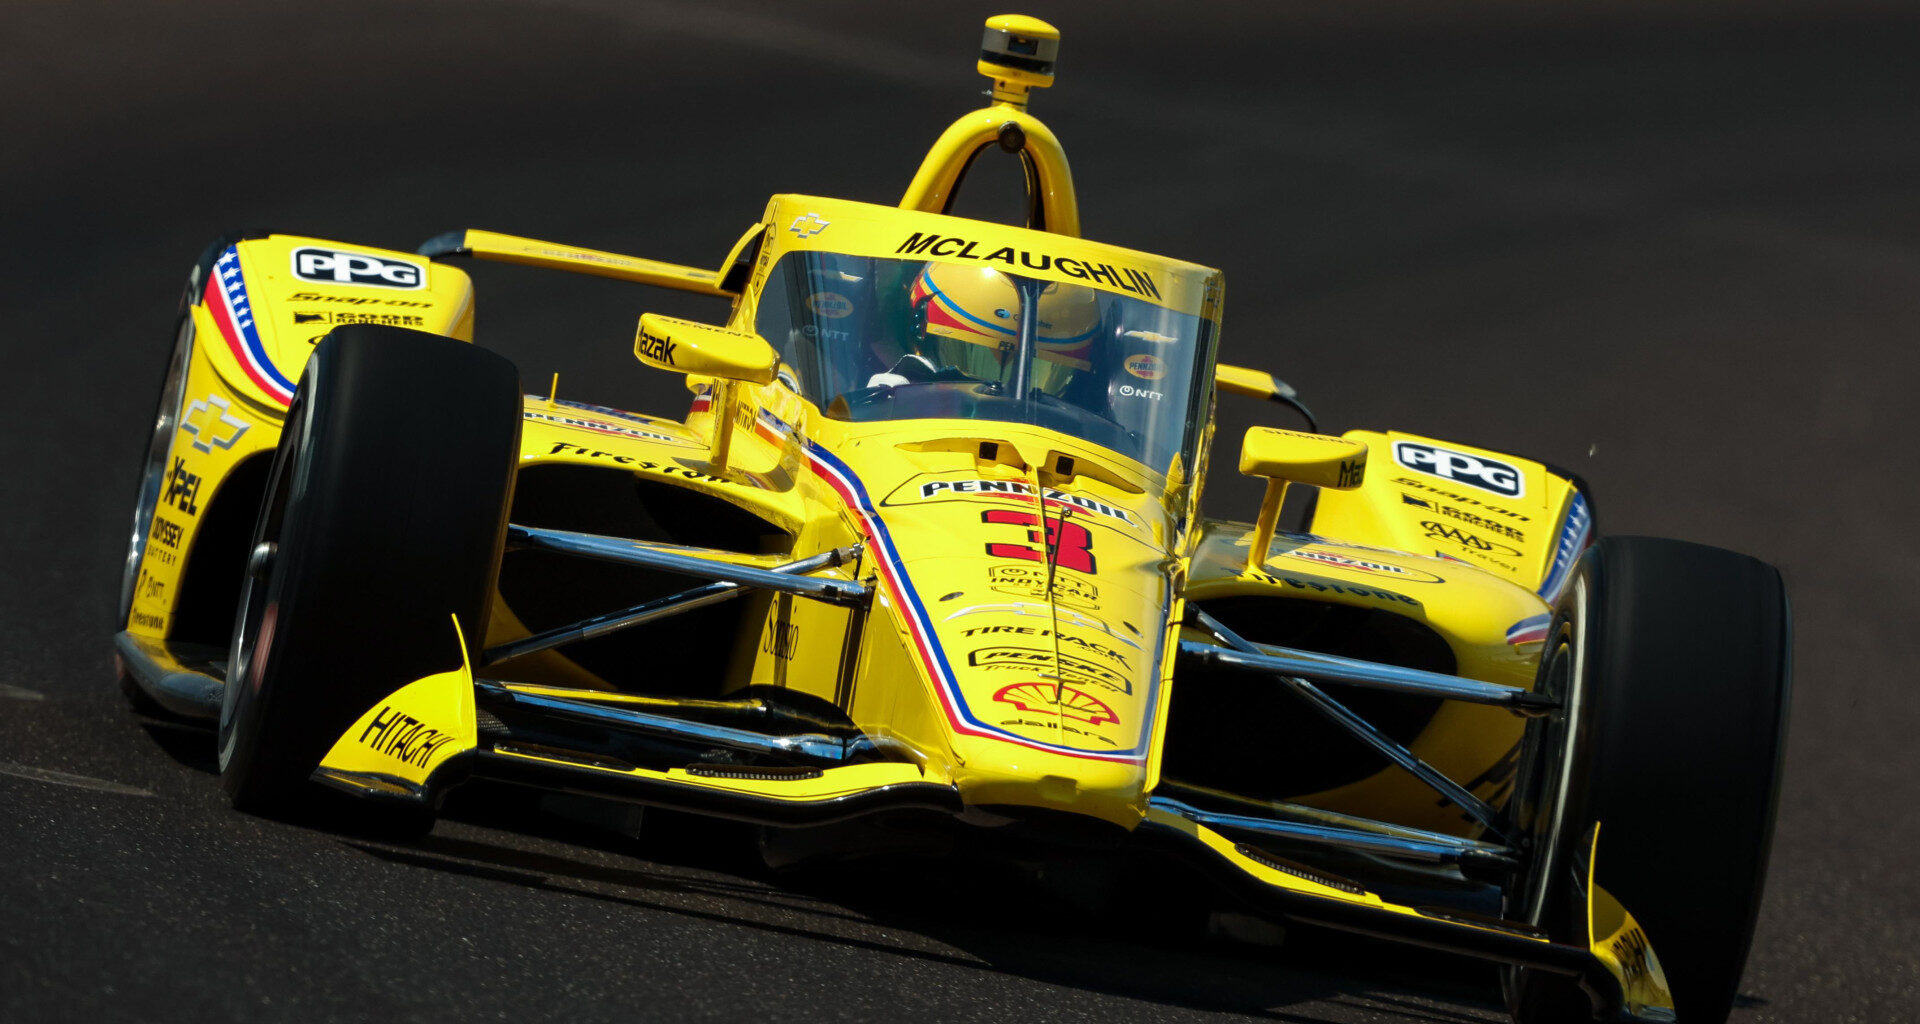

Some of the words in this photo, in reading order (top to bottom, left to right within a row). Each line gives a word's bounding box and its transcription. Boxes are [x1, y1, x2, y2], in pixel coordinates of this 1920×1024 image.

[298, 252, 417, 285] PPG
[895, 232, 1162, 300] MCLAUGHLIN
[336, 312, 423, 321] GOOD
[659, 317, 754, 339] SIEMENS
[821, 328, 849, 341] NTT
[1135, 388, 1164, 401] NTT
[549, 441, 732, 484] Fireston
[1400, 446, 1517, 491] PPG
[163, 455, 201, 517] XPEL
[920, 479, 1138, 529] PENNZOIL
[1442, 505, 1524, 537] GOOD
[152, 516, 184, 550] ODYSSEY
[981, 509, 1098, 576] 3
[960, 626, 1036, 638] TIRE
[1041, 629, 1135, 673] RACK
[983, 651, 1122, 682] PENSKE
[358, 705, 456, 769] HITACHI
[1000, 718, 1119, 747] dallara
